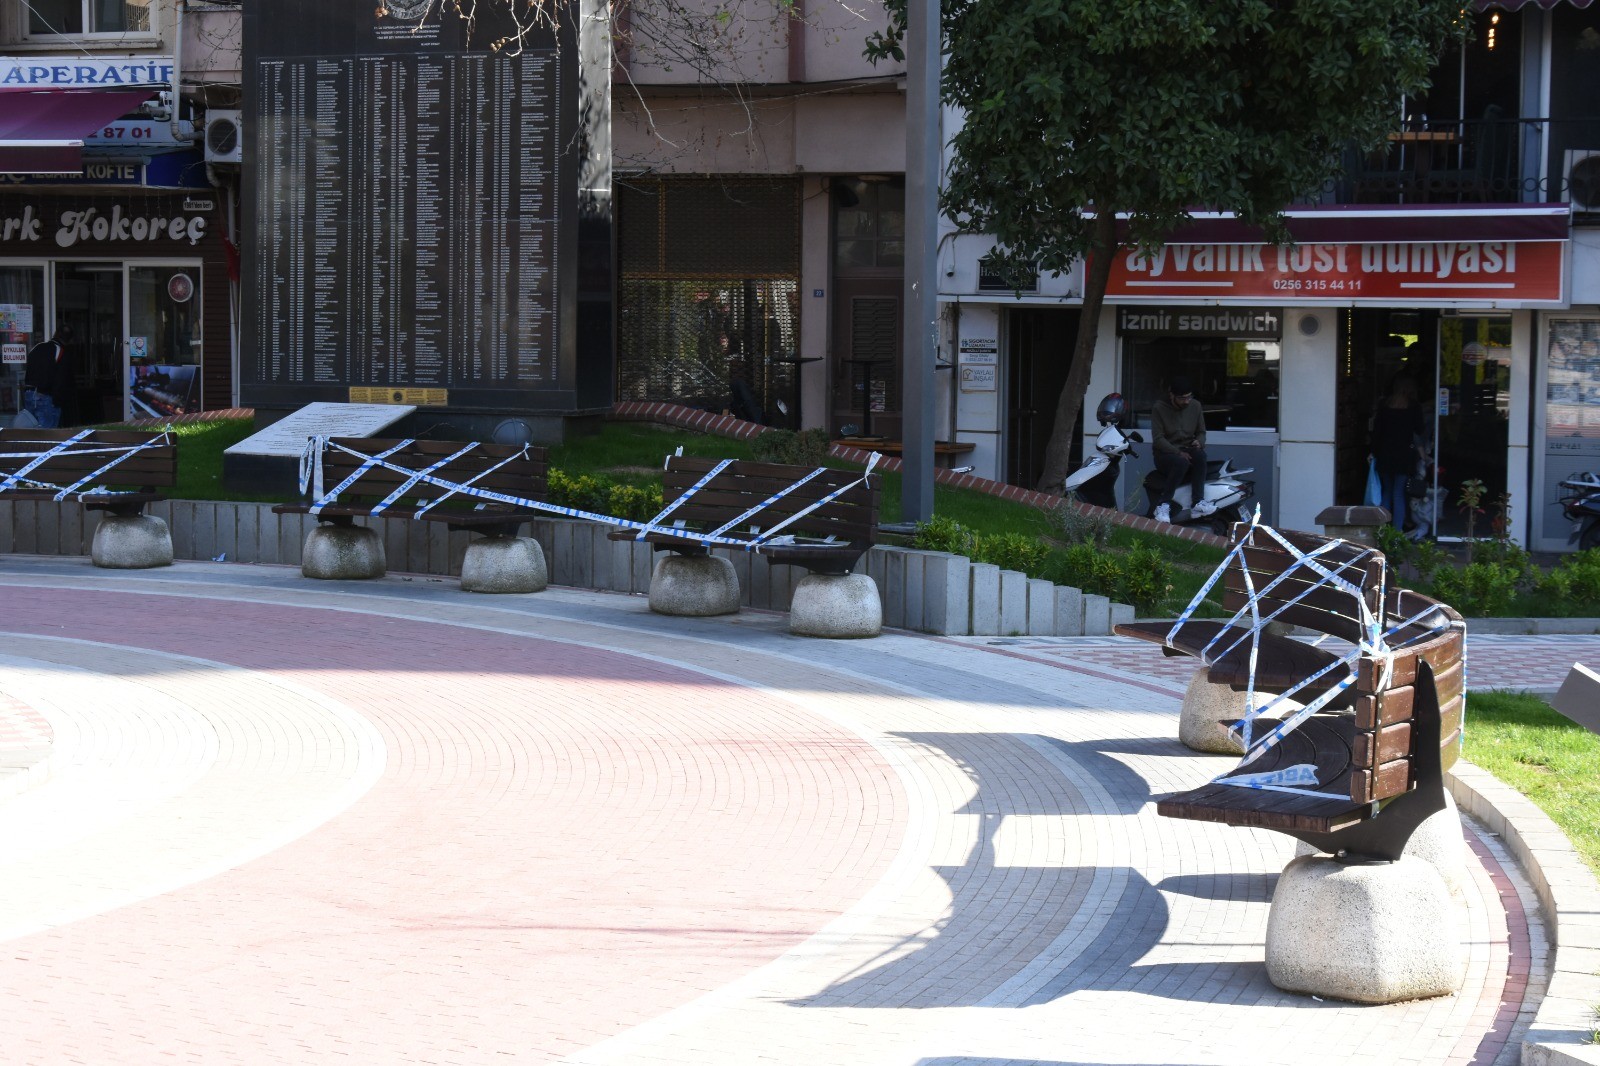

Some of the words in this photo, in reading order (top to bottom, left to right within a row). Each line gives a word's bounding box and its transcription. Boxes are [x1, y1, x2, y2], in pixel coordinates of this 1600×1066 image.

[103, 127, 125, 138] 87
[131, 127, 151, 138] 01
[0, 205, 42, 241] rk
[55, 204, 206, 248] Kokoreç
[1273, 280, 1302, 290] 0256
[1305, 280, 1327, 290] 315
[1329, 280, 1345, 290] 44
[1347, 280, 1362, 290] 11
[1121, 309, 1172, 331] izmir
[1178, 311, 1278, 332] sandwich
[332, 475, 356, 496] ZABITA
